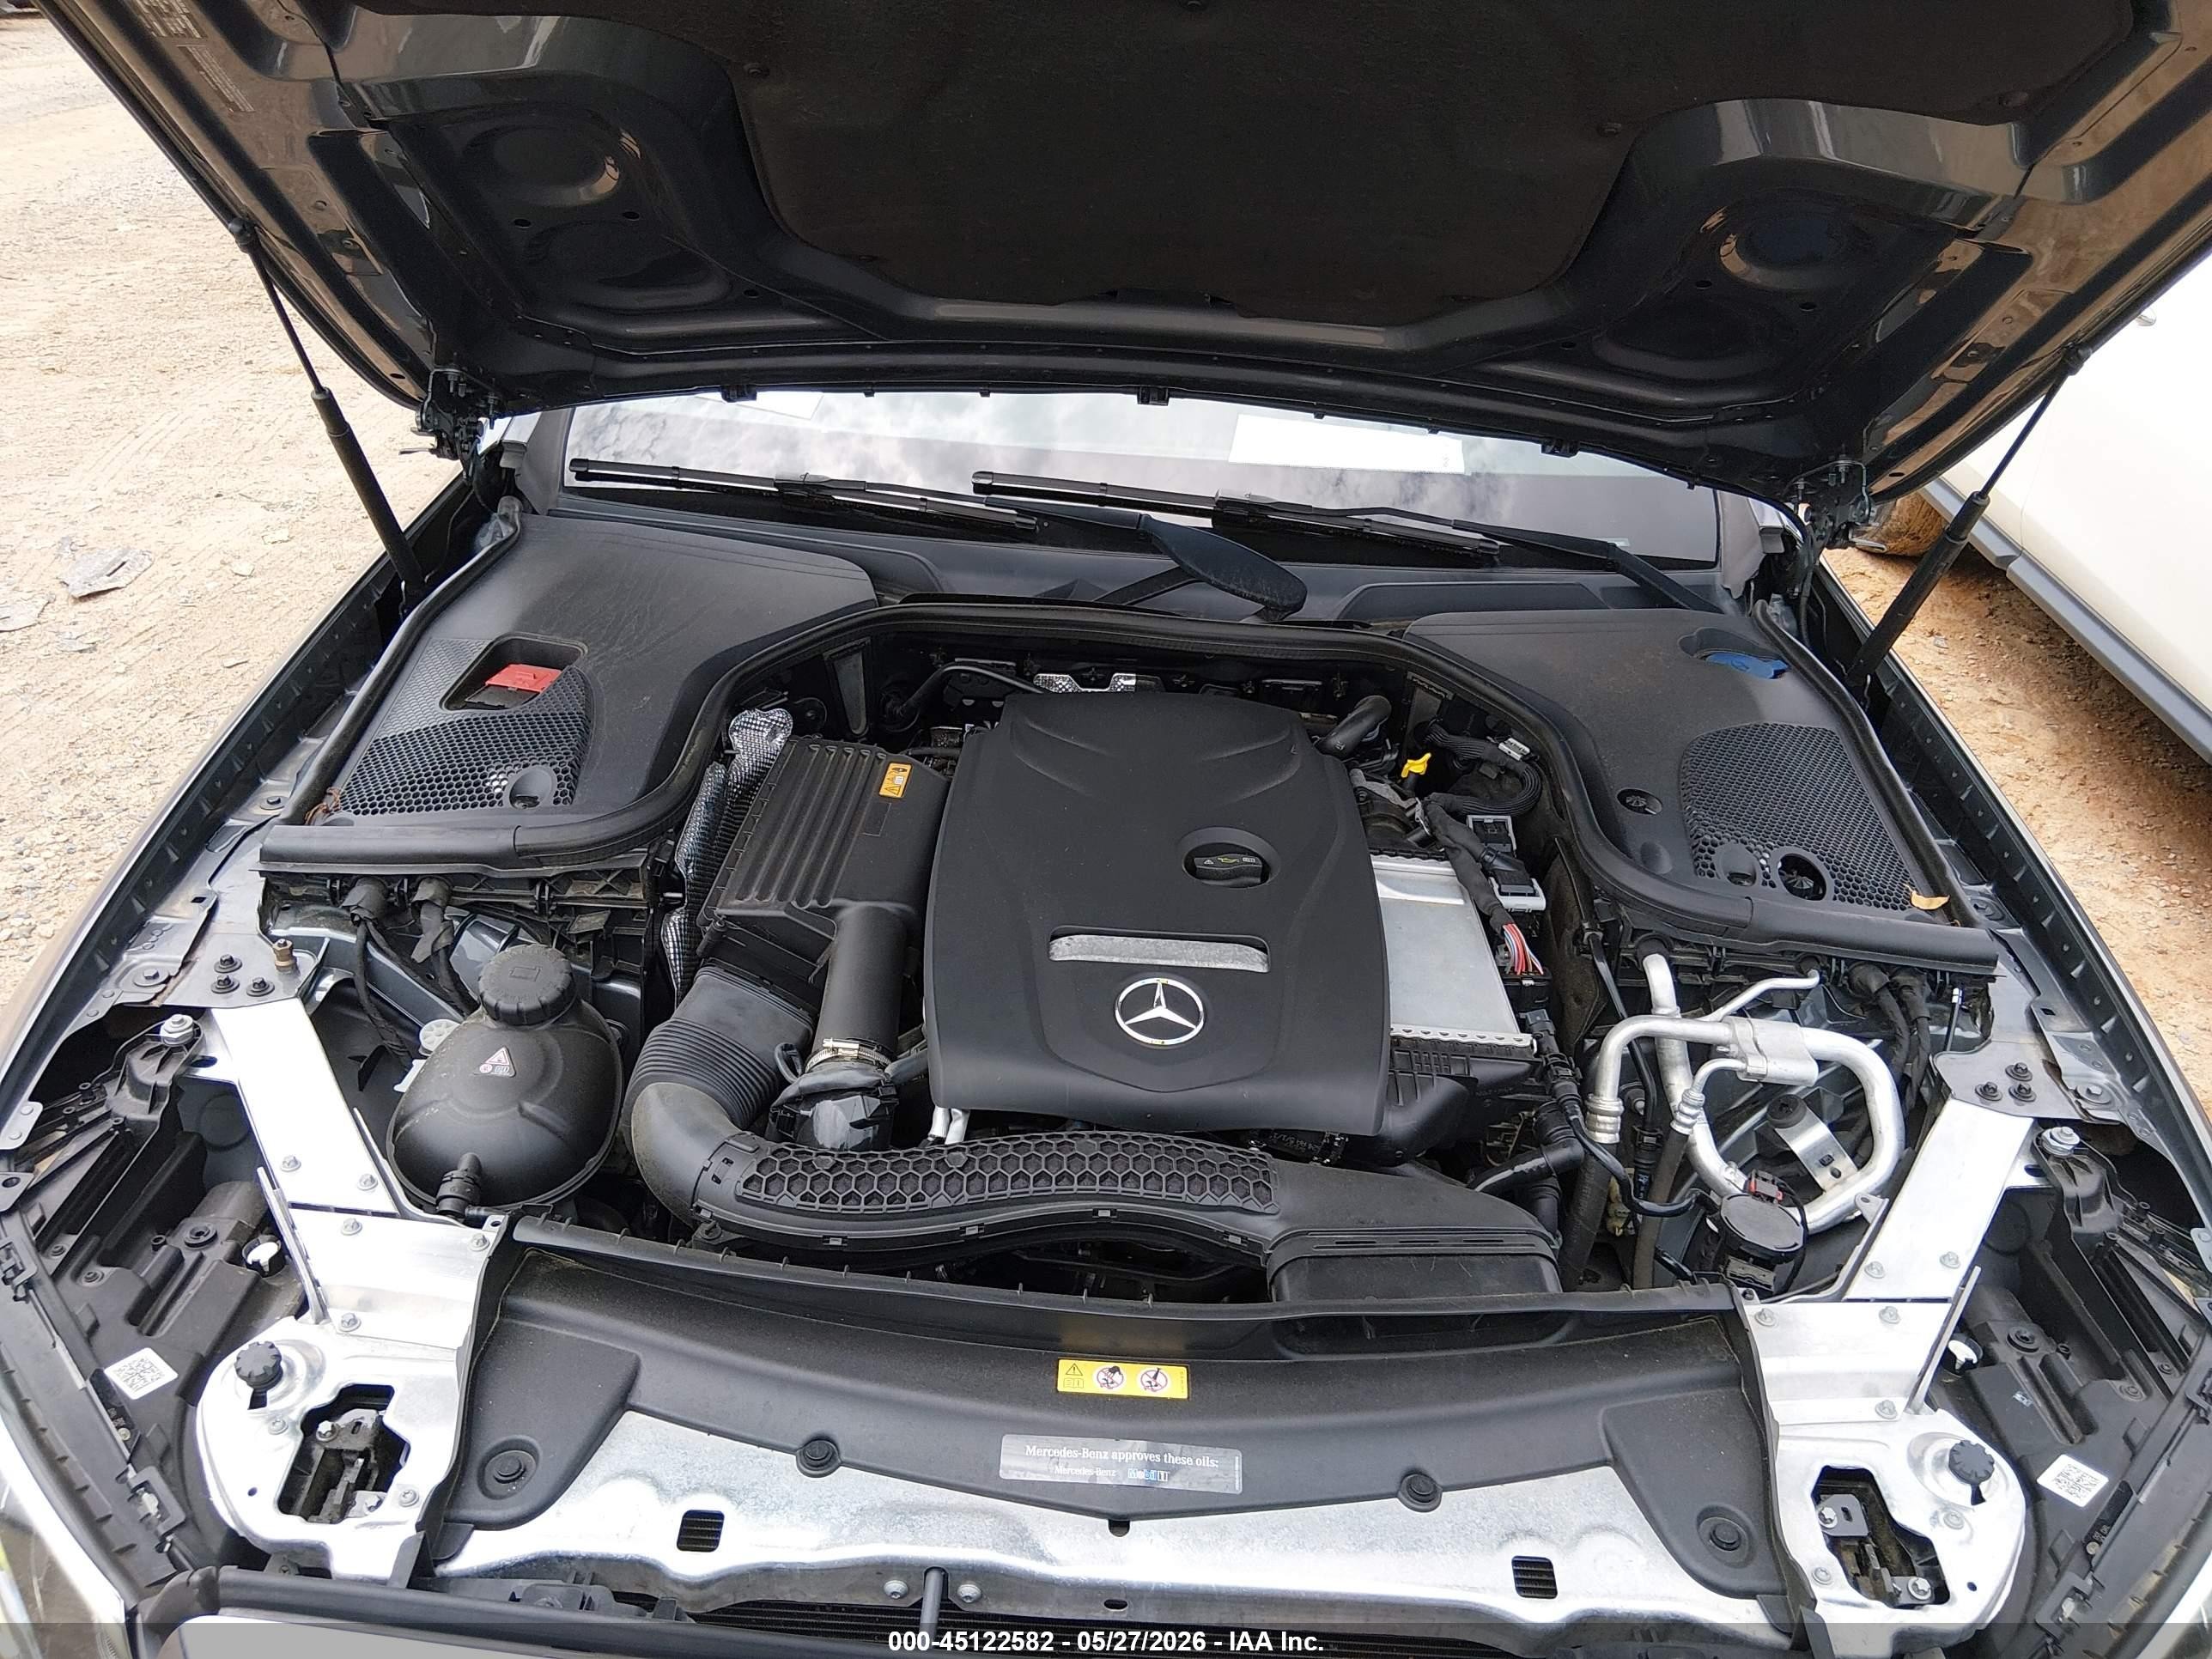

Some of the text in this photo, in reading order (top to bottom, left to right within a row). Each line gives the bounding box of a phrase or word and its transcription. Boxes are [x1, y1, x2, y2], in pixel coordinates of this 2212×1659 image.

[1025, 1445, 1219, 1468] Mercedes-Benz approves these oils:
[1054, 1464, 1116, 1477] Mercedes-Benz
